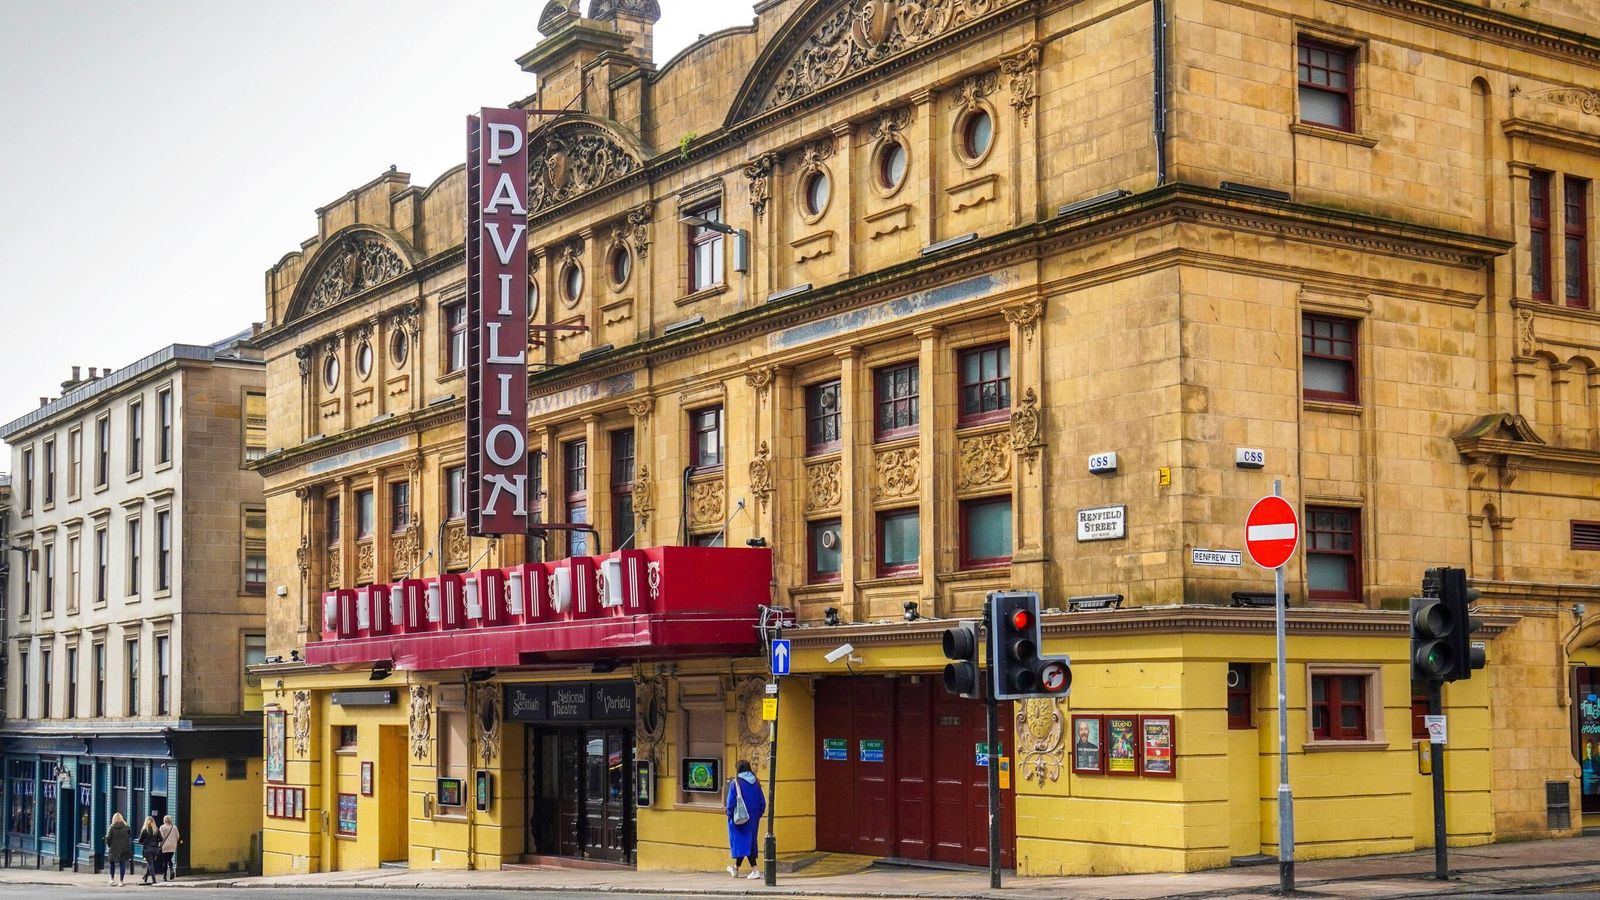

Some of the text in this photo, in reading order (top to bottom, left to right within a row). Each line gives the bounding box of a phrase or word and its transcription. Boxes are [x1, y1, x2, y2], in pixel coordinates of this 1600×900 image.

[483, 122, 527, 516] PAVILION
[1080, 510, 1122, 522] RENFIELD
[1084, 522, 1117, 532] STREET
[1194, 553, 1226, 562] RENFREW
[516, 690, 526, 700] The
[557, 688, 586, 703] National
[513, 698, 540, 715] Scottish
[552, 701, 578, 716] Theatre
[604, 695, 631, 714] Variety
[1112, 720, 1132, 728] LEGEND
